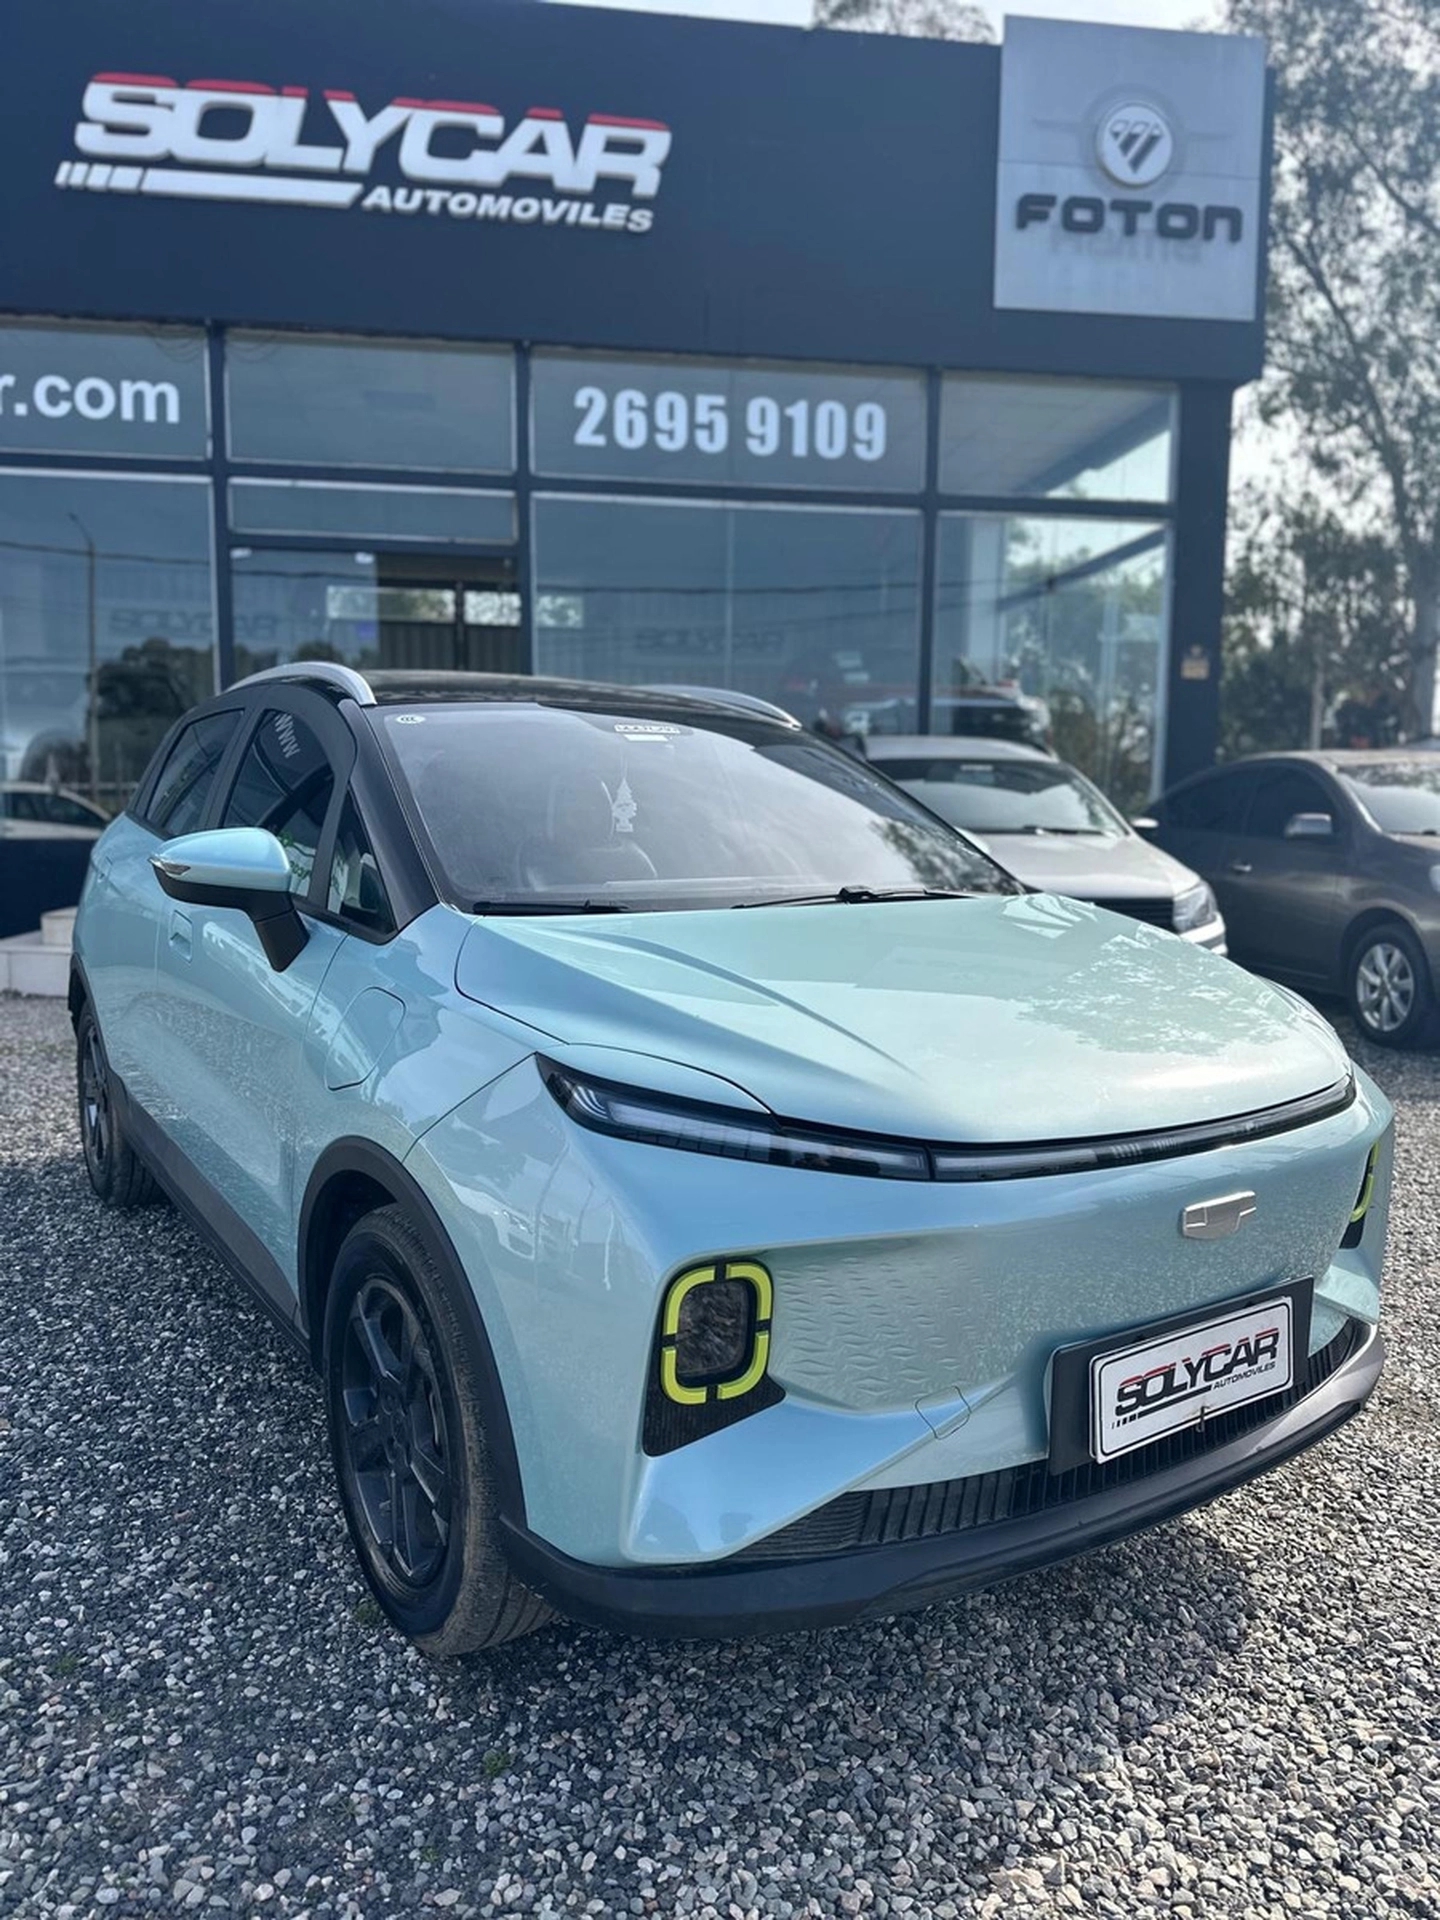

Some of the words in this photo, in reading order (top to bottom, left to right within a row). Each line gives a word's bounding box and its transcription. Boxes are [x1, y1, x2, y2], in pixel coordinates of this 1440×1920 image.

[74, 72, 672, 198] SOLYCAR
[362, 185, 655, 233] AUTOMOVILES
[1015, 193, 1243, 244] FOTON
[574, 386, 729, 454] 2695
[746, 396, 888, 462] 9109
[1115, 1327, 1279, 1416] SOLYCAR
[1213, 1361, 1276, 1390] AUTOMOVILES
